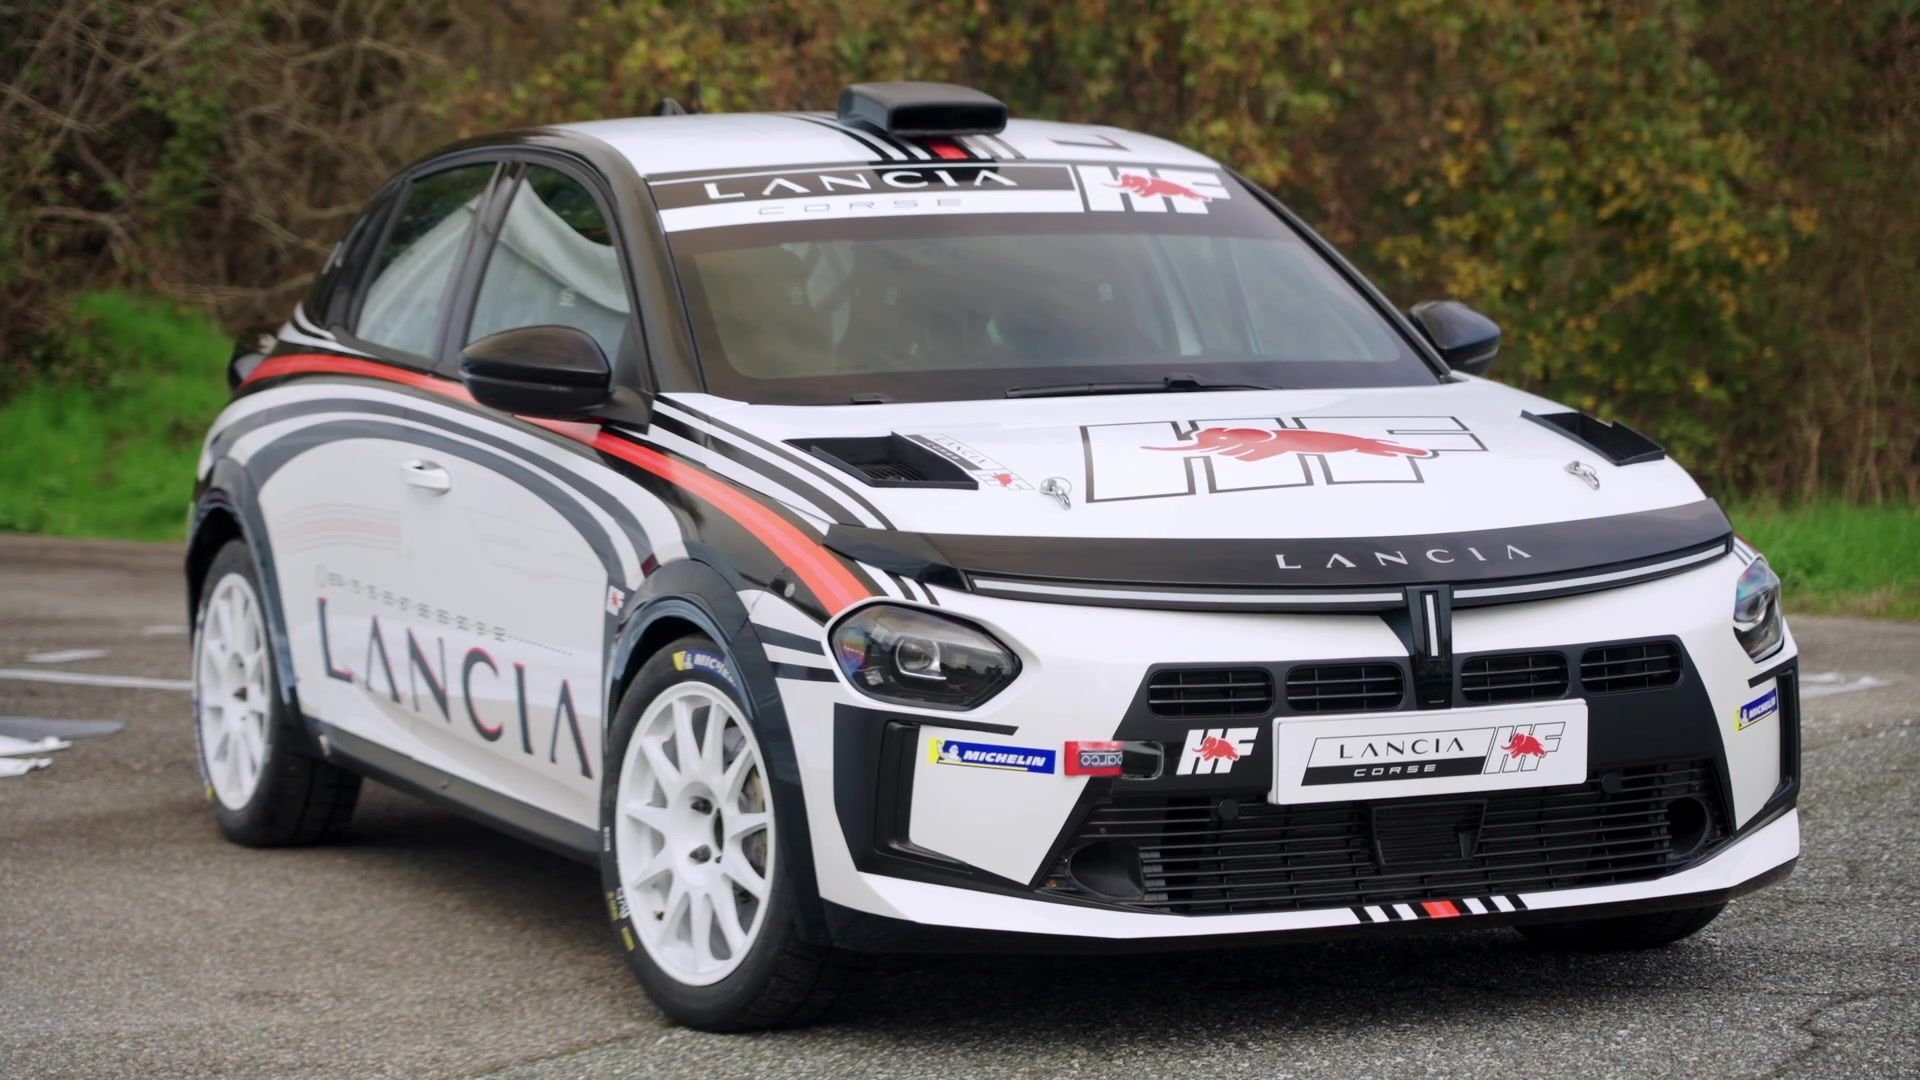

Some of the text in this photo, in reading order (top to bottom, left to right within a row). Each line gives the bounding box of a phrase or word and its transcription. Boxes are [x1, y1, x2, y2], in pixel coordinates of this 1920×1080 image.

[703, 169, 1018, 200] LANCIA
[758, 197, 962, 216] CORSE
[1275, 544, 1532, 570] LANCIA
[316, 596, 594, 780] LANCIA
[963, 749, 1047, 767] MICHELIN
[1339, 736, 1464, 760] LANCIA
[1353, 763, 1437, 778] CORSE
